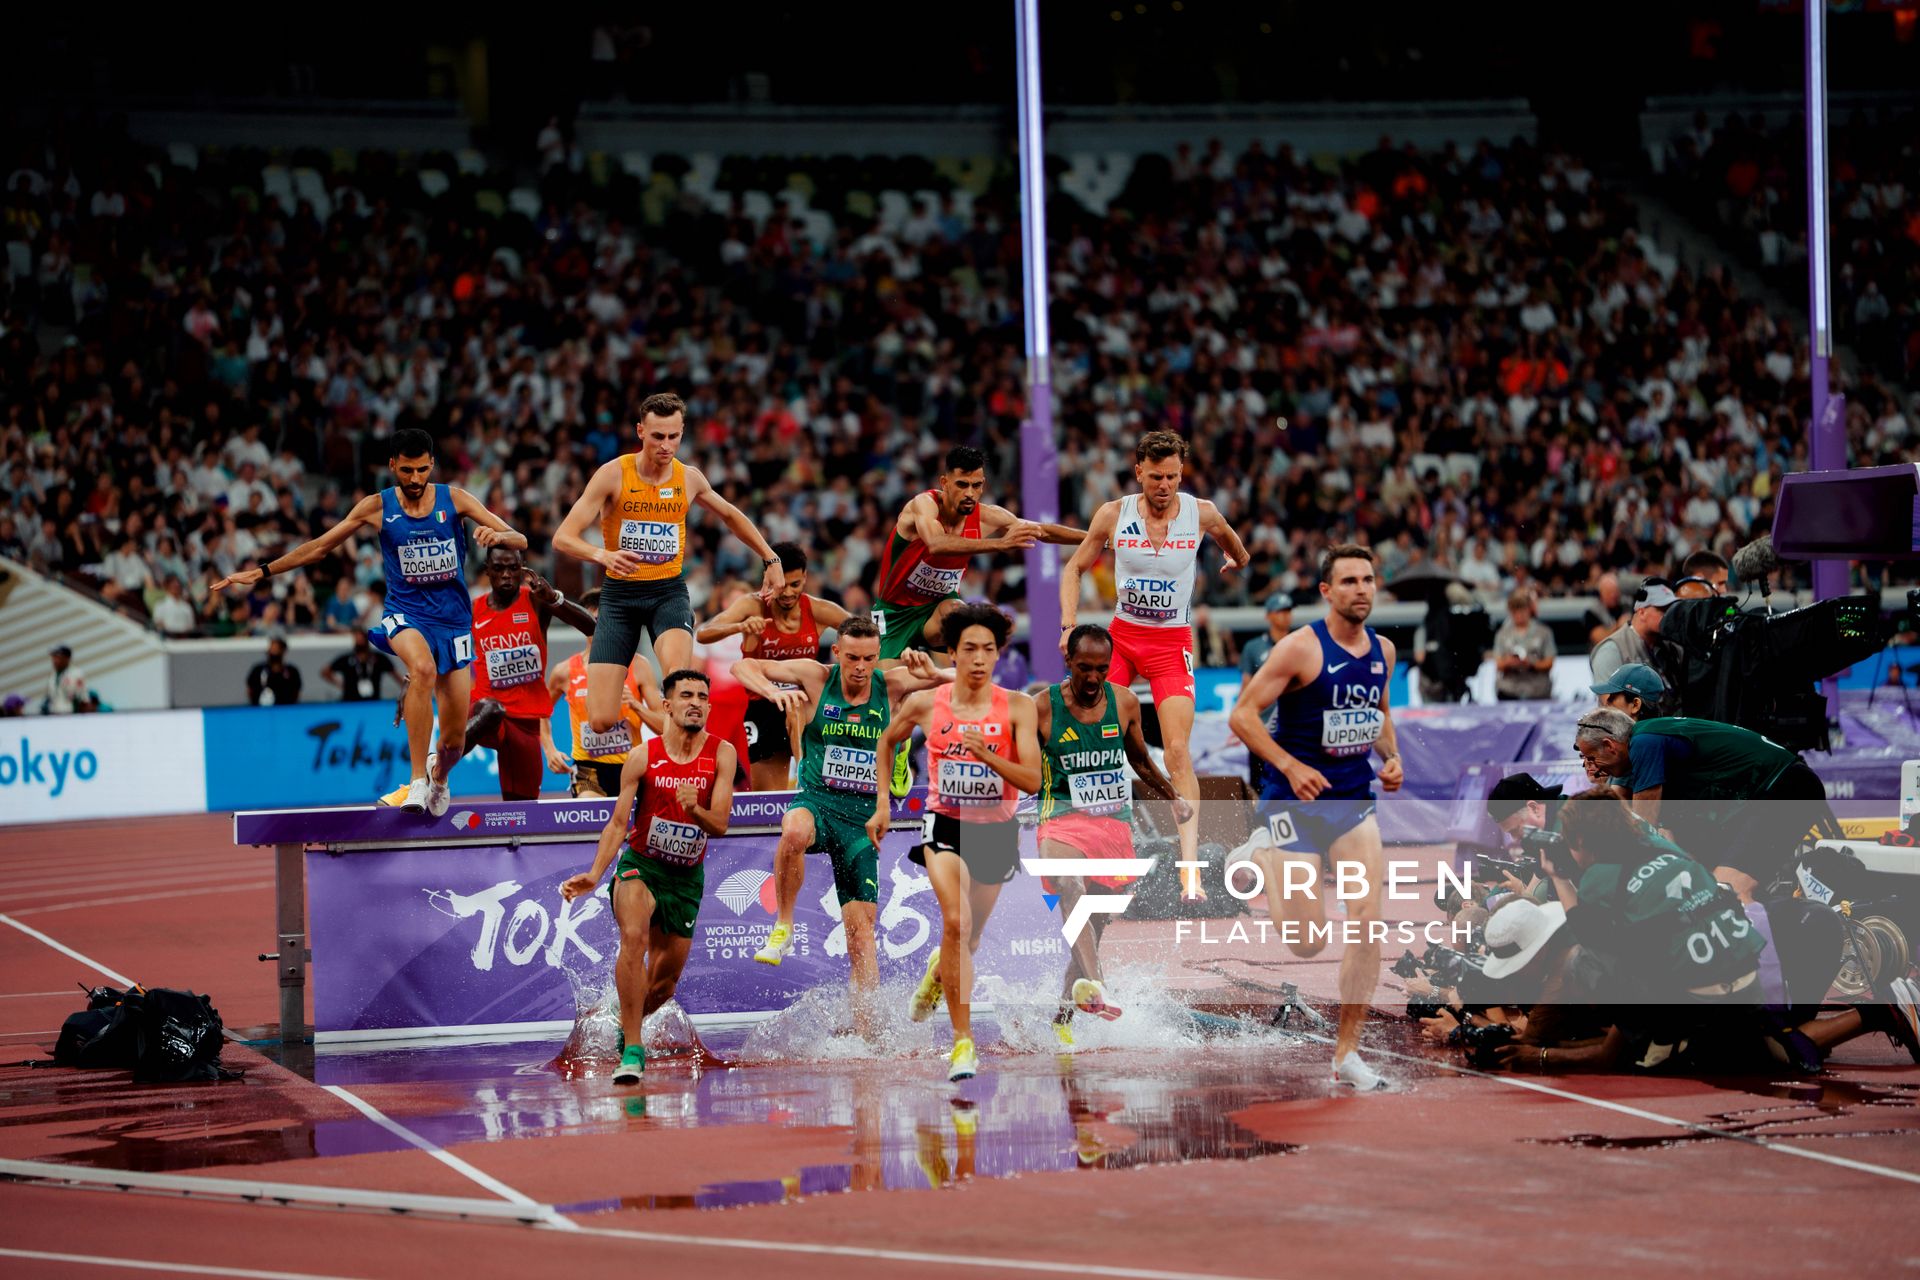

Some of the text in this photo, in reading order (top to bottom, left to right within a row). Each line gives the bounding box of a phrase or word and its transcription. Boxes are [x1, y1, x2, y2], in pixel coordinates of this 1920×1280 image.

[623, 501, 683, 513] GERMANY
[637, 522, 674, 537] TDK
[414, 540, 453, 558] TDK
[621, 536, 676, 553] BEBENDORF
[1117, 539, 1196, 550] FRANCE
[403, 555, 456, 575] ZOGHLAMI
[932, 570, 958, 581] TDK
[1136, 578, 1177, 593] TDK
[1128, 591, 1172, 608] DARU
[461, 639, 468, 657] 1
[480, 631, 532, 654] KENYA
[499, 646, 535, 662] TDK
[764, 646, 816, 658] TUNISIA
[491, 658, 539, 678] SEREM
[1332, 683, 1380, 709] USA
[1342, 710, 1380, 725] TDK
[822, 723, 882, 739] AUSTRALIA
[1327, 726, 1379, 744] UPDIKE
[583, 732, 630, 748] QUIJADA
[1060, 748, 1124, 770] ETHIOPIA
[955, 762, 998, 778] TDK
[1086, 769, 1126, 786] TDK
[943, 779, 998, 796] MIURA
[1079, 785, 1125, 804] WALE
[554, 808, 610, 824] WORLD
[1272, 818, 1292, 842] 10
[650, 834, 661, 848] EL
[1807, 876, 1830, 901] TDK
[705, 926, 746, 936] WORLD
[1687, 909, 1749, 964] 013
